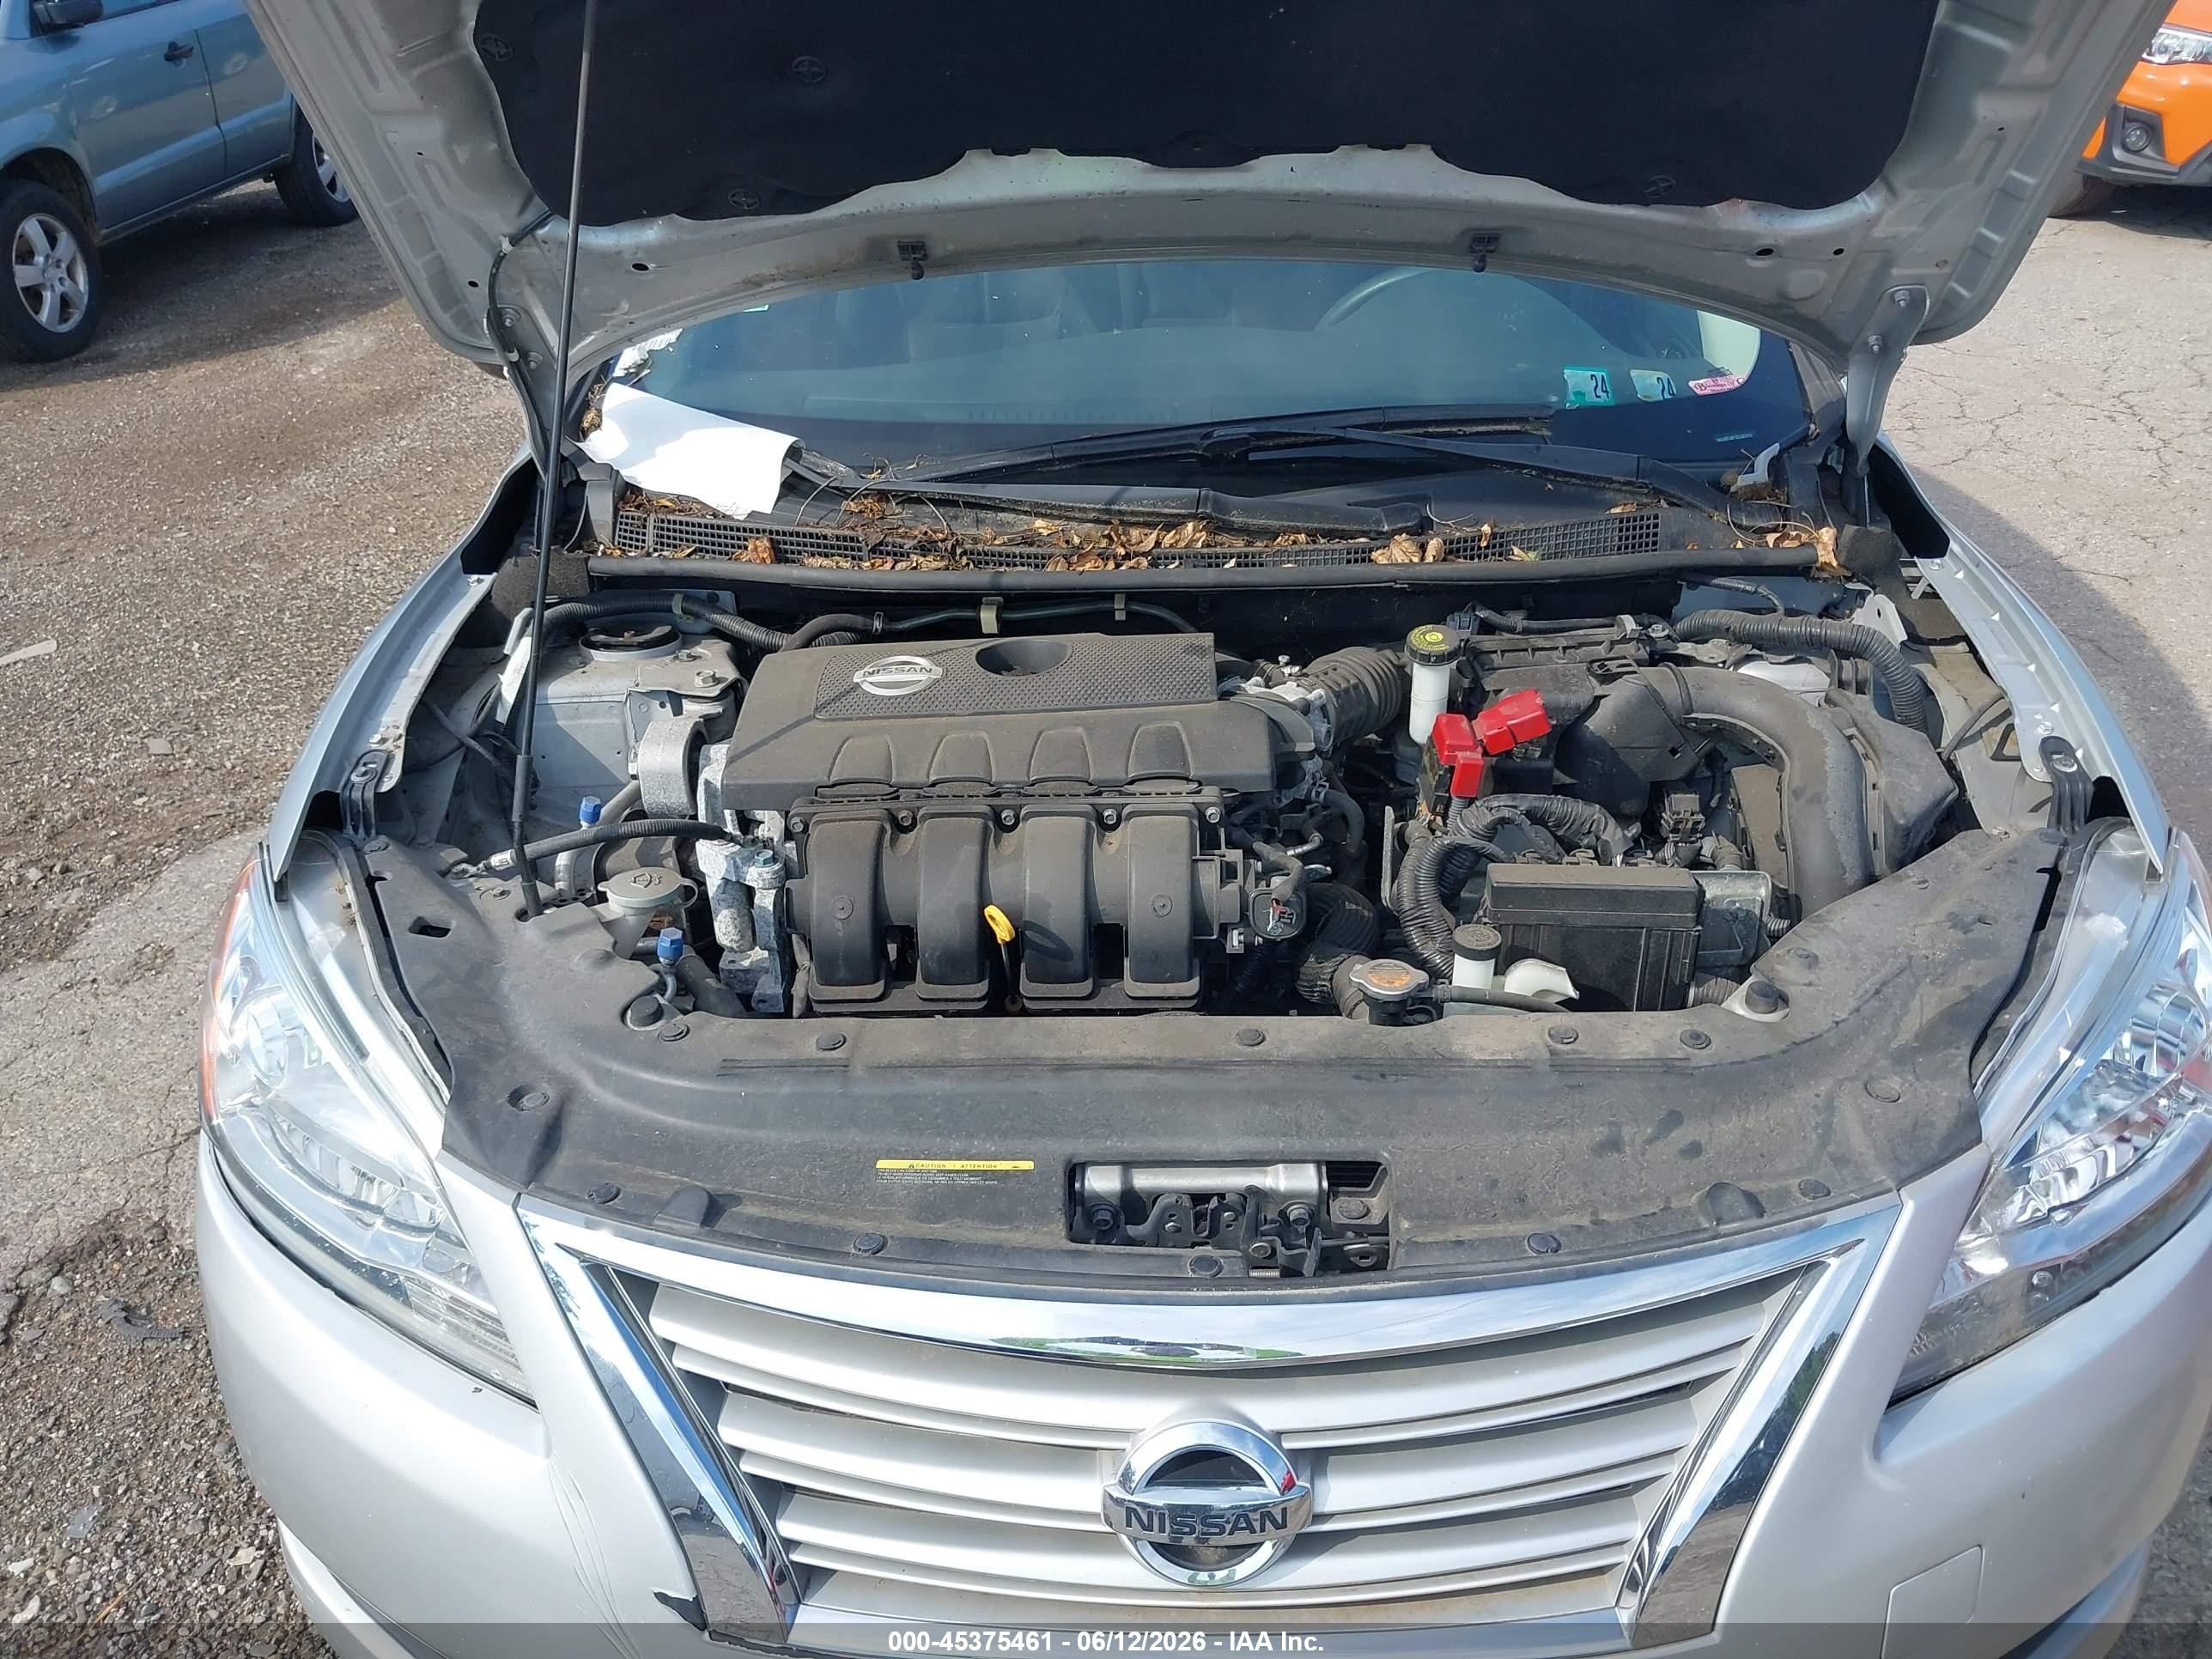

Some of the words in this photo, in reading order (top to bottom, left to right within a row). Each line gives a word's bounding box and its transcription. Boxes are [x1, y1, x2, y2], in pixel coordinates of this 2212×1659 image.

[1590, 374, 1610, 399] 24
[1656, 376, 1676, 400] 24
[862, 666, 933, 677] NISSAN
[1125, 1506, 1288, 1537] NISSAN
